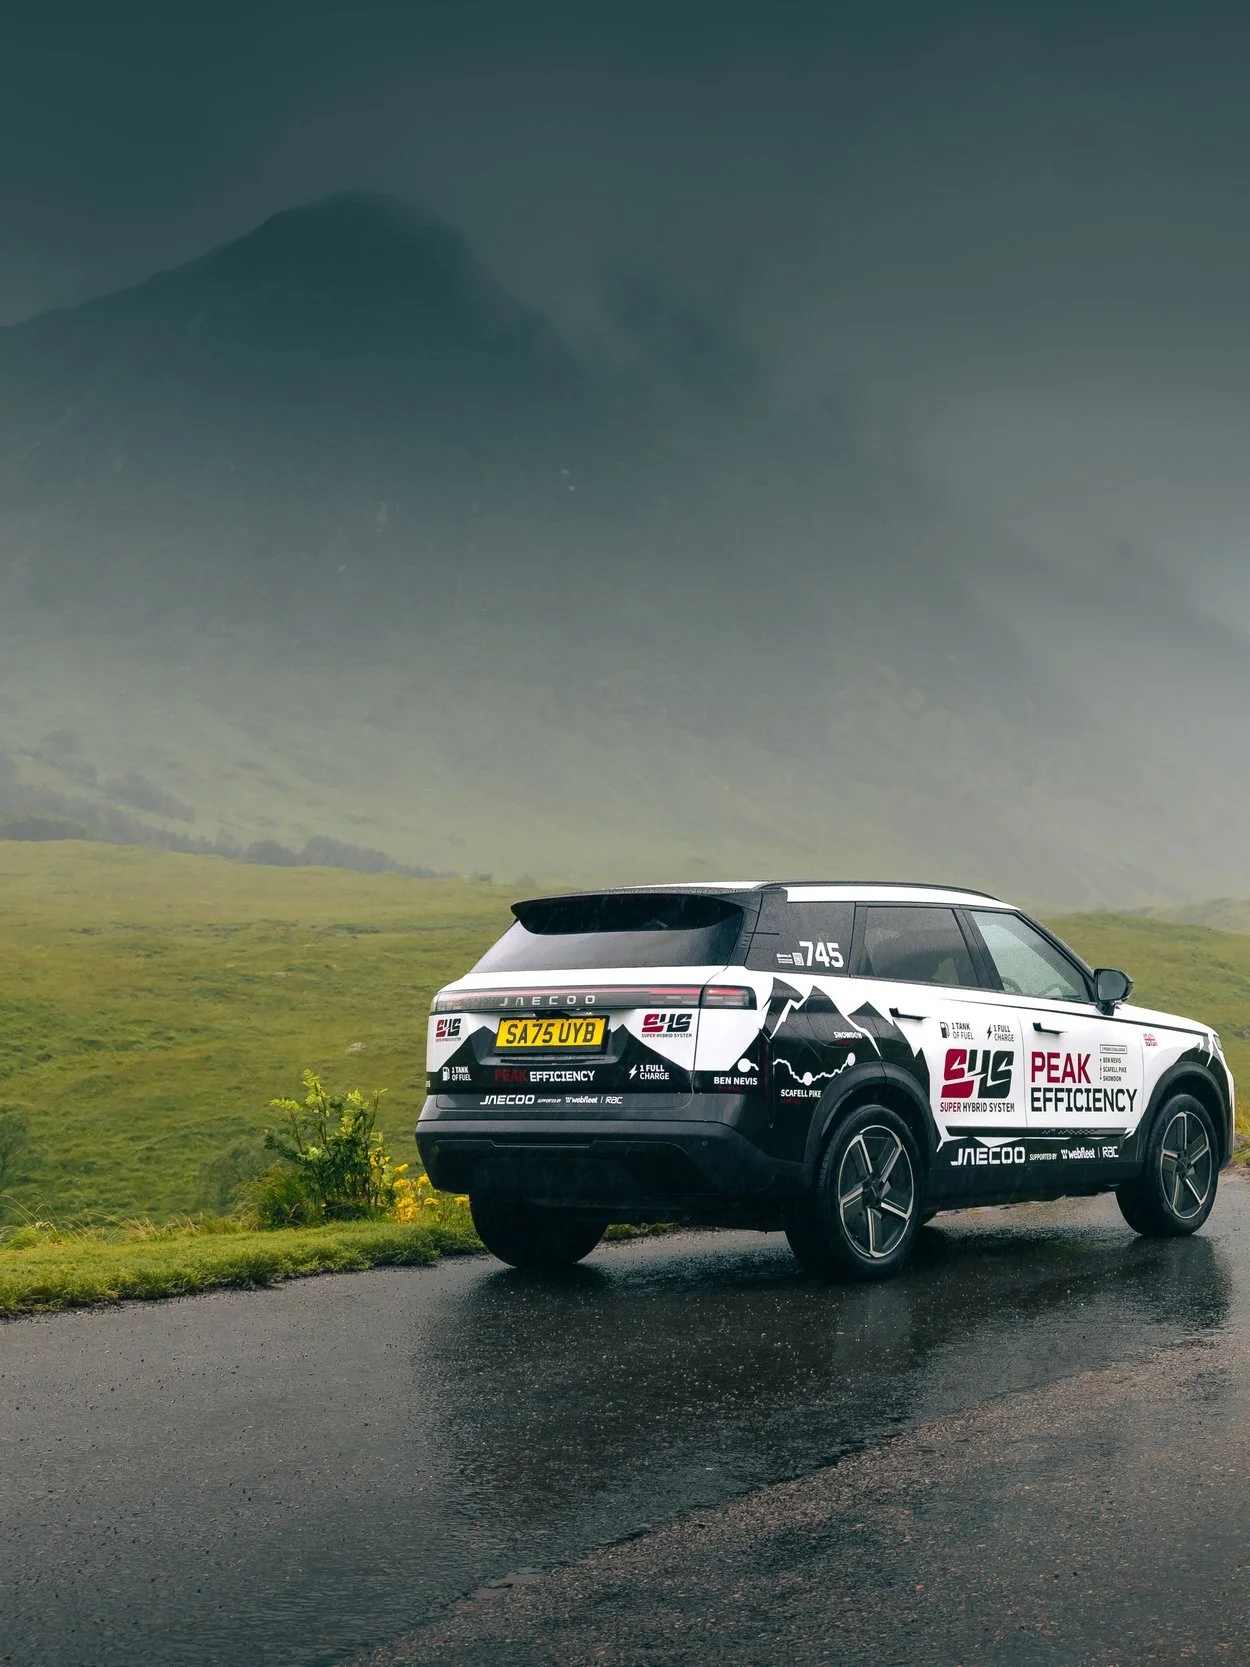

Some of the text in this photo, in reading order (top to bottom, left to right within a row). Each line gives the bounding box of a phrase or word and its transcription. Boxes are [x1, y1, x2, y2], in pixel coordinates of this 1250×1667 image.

[799, 941, 844, 967] 745
[500, 995, 595, 1006] JAECOO
[506, 1022, 596, 1044] SA75 UYB
[998, 1025, 1011, 1033] FULL
[833, 1031, 862, 1039] SNOWDON
[952, 1031, 974, 1040] OF FUEL
[994, 1033, 1014, 1042] CHARGE
[1031, 1051, 1092, 1084] PEAK
[494, 1069, 595, 1082] PEAK EFFICIENCY
[640, 1072, 670, 1080] CHARGE
[713, 1076, 758, 1086] BEN NEVIS
[780, 1089, 822, 1098] SCAFELL PIKE
[480, 1094, 535, 1105] JAECOO
[1031, 1087, 1138, 1112] EFFICIENCY
[940, 1101, 1015, 1113] SUPER HYBRID SYSTEM
[950, 1147, 1026, 1166] JAECOO
[1069, 1147, 1096, 1159] webfleet
